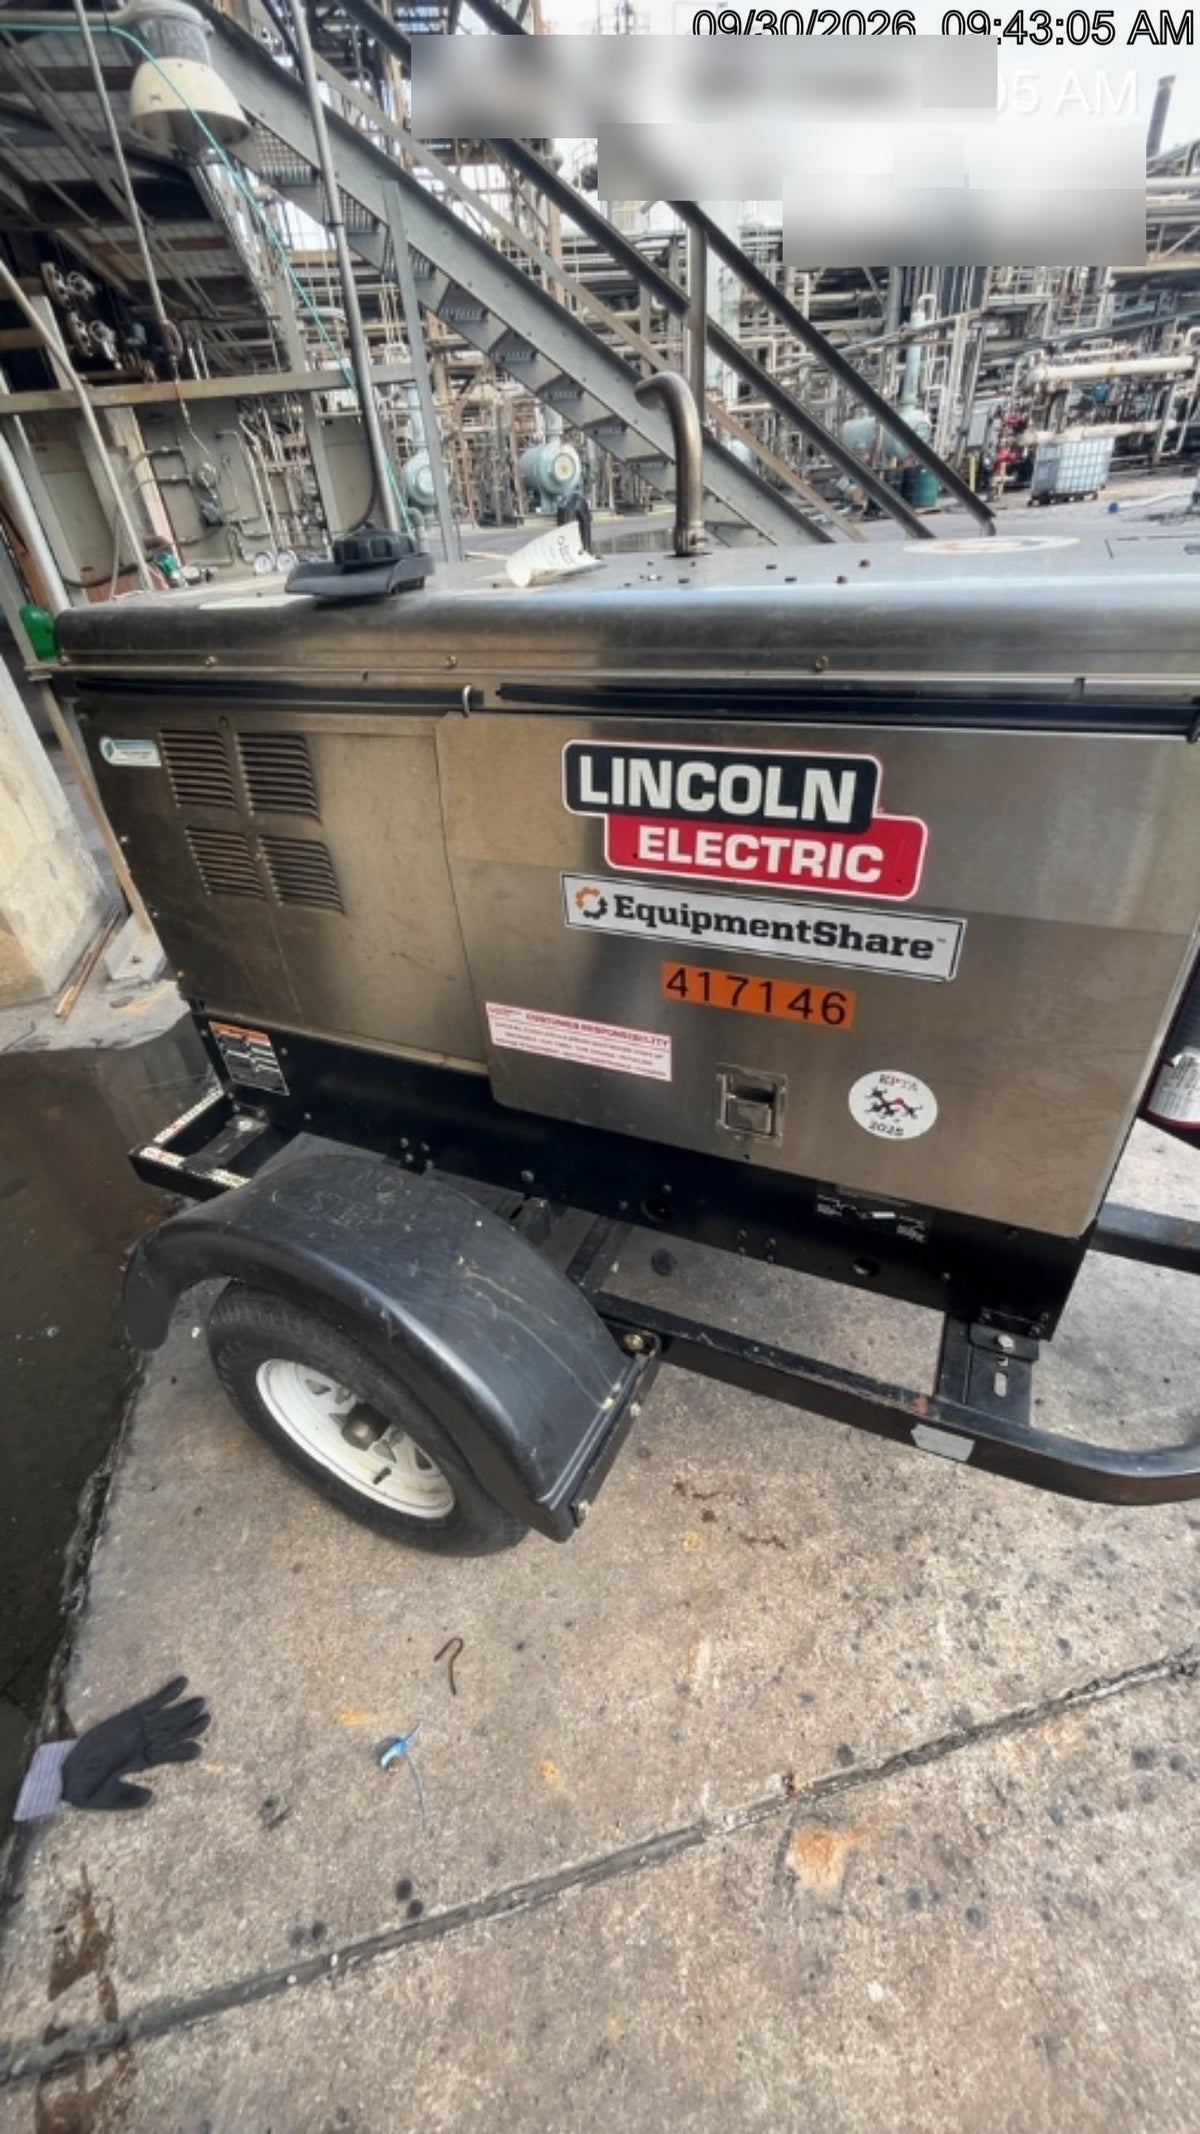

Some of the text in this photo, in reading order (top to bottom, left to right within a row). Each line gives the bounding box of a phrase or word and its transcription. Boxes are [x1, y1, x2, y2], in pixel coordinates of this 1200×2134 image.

[579, 755, 857, 824] LINCOLN
[638, 825, 885, 883] ELECTRIC
[612, 893, 935, 961] EquipmentShare
[665, 967, 848, 1026] 417146
[581, 1022, 669, 1047] RESPONSIBILITY
[868, 1120, 905, 1136] 2025
